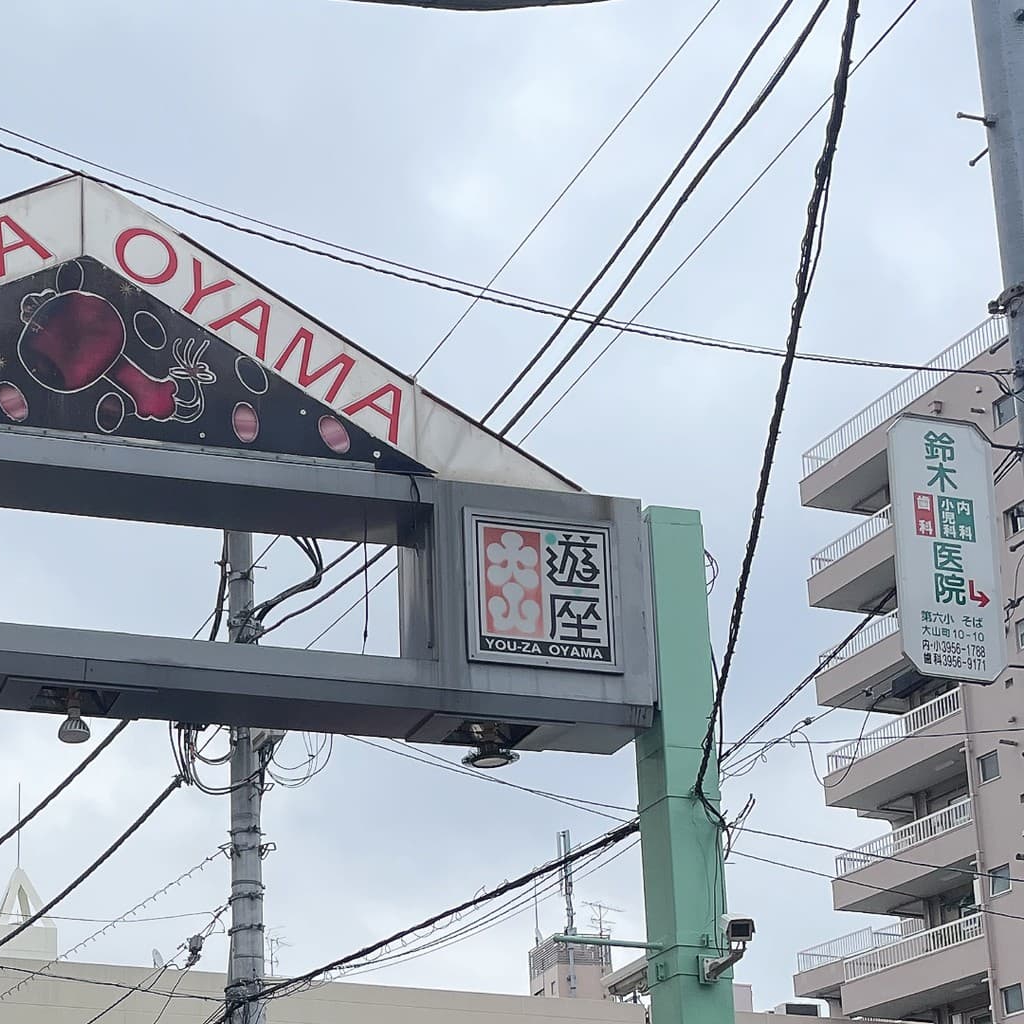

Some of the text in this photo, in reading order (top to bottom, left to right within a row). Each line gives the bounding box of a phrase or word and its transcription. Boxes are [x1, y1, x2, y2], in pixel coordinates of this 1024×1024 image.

[114, 227, 404, 446] OYAMA
[923, 430, 958, 493] 鈴木
[956, 500, 972, 541] 内科
[546, 533, 602, 644] 遊座
[933, 541, 967, 606] 医院
[485, 637, 603, 660] YOU-ZA OYAMA
[961, 615, 984, 629] そば
